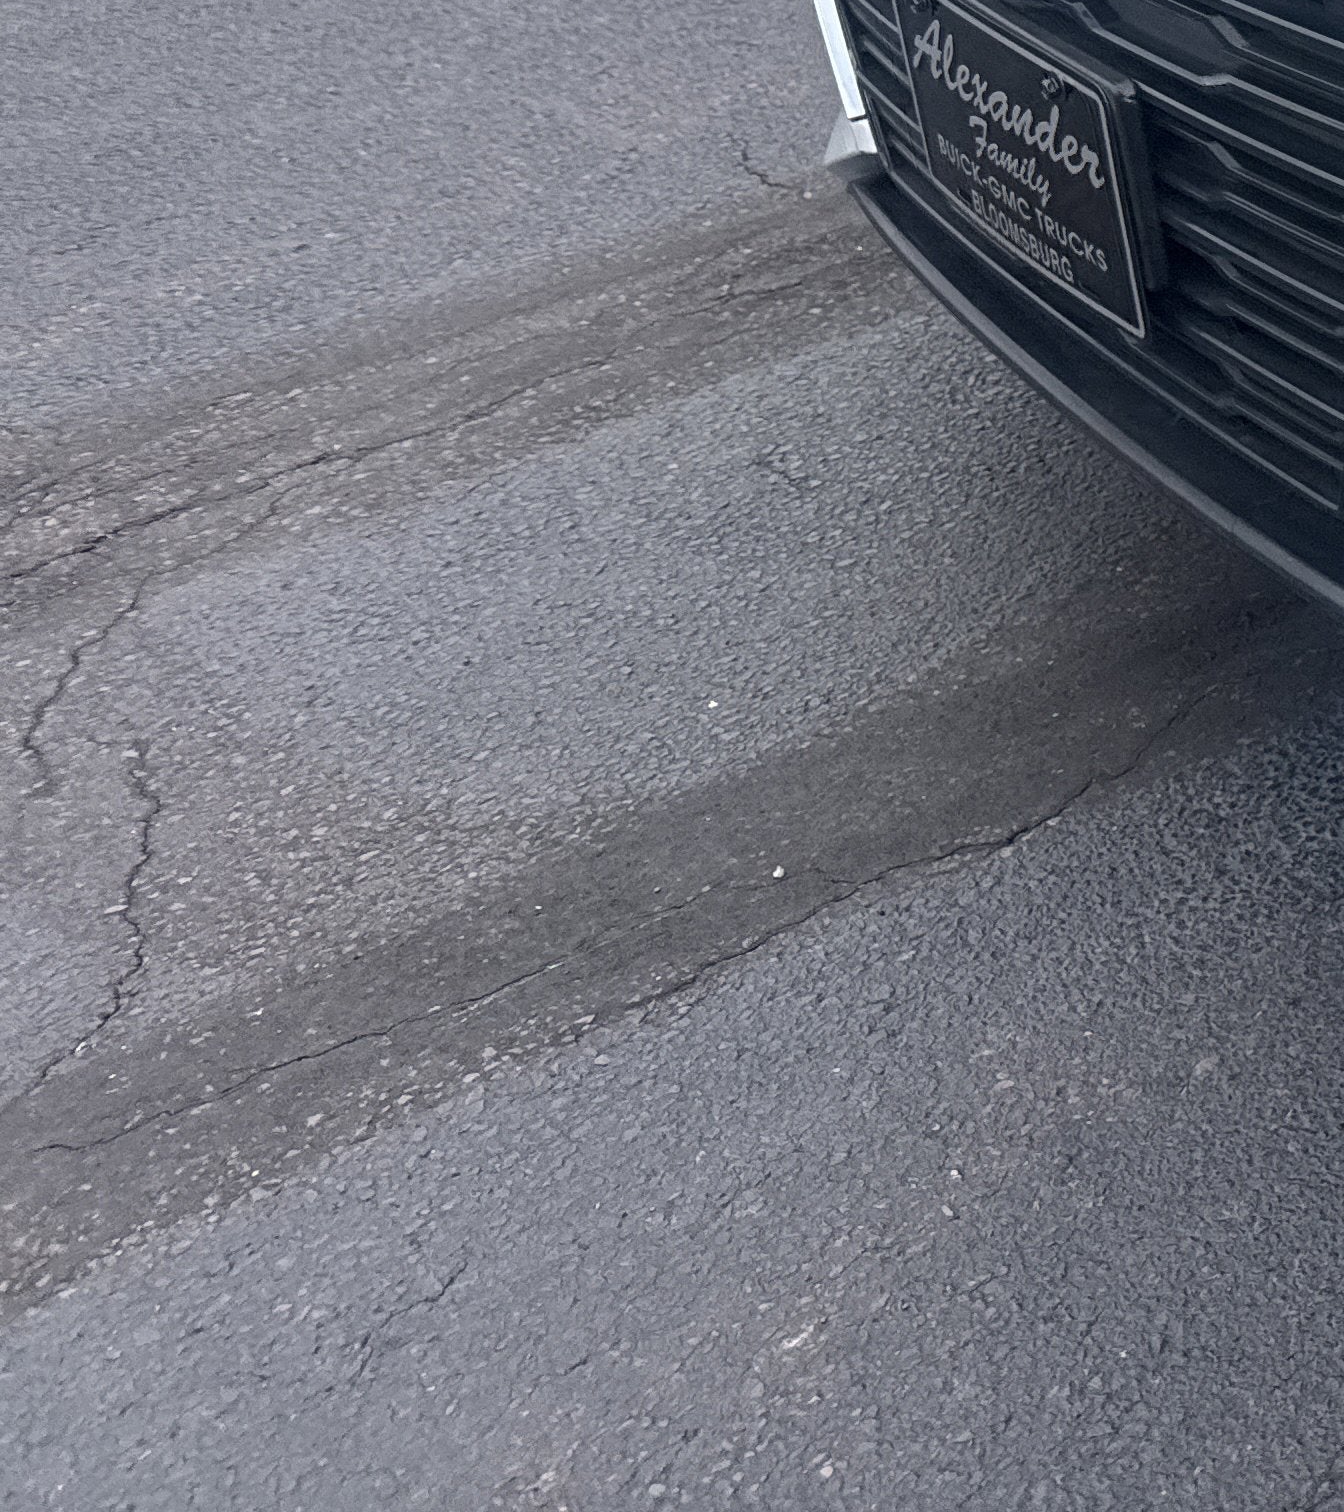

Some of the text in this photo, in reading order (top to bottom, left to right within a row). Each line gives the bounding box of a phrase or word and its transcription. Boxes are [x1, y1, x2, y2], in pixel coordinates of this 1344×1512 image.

[913, 20, 1105, 188] Alexander
[969, 115, 1051, 208] Family
[972, 189, 1074, 284] BLOOMSBURG
[1035, 207, 1109, 272] TRUCKS
